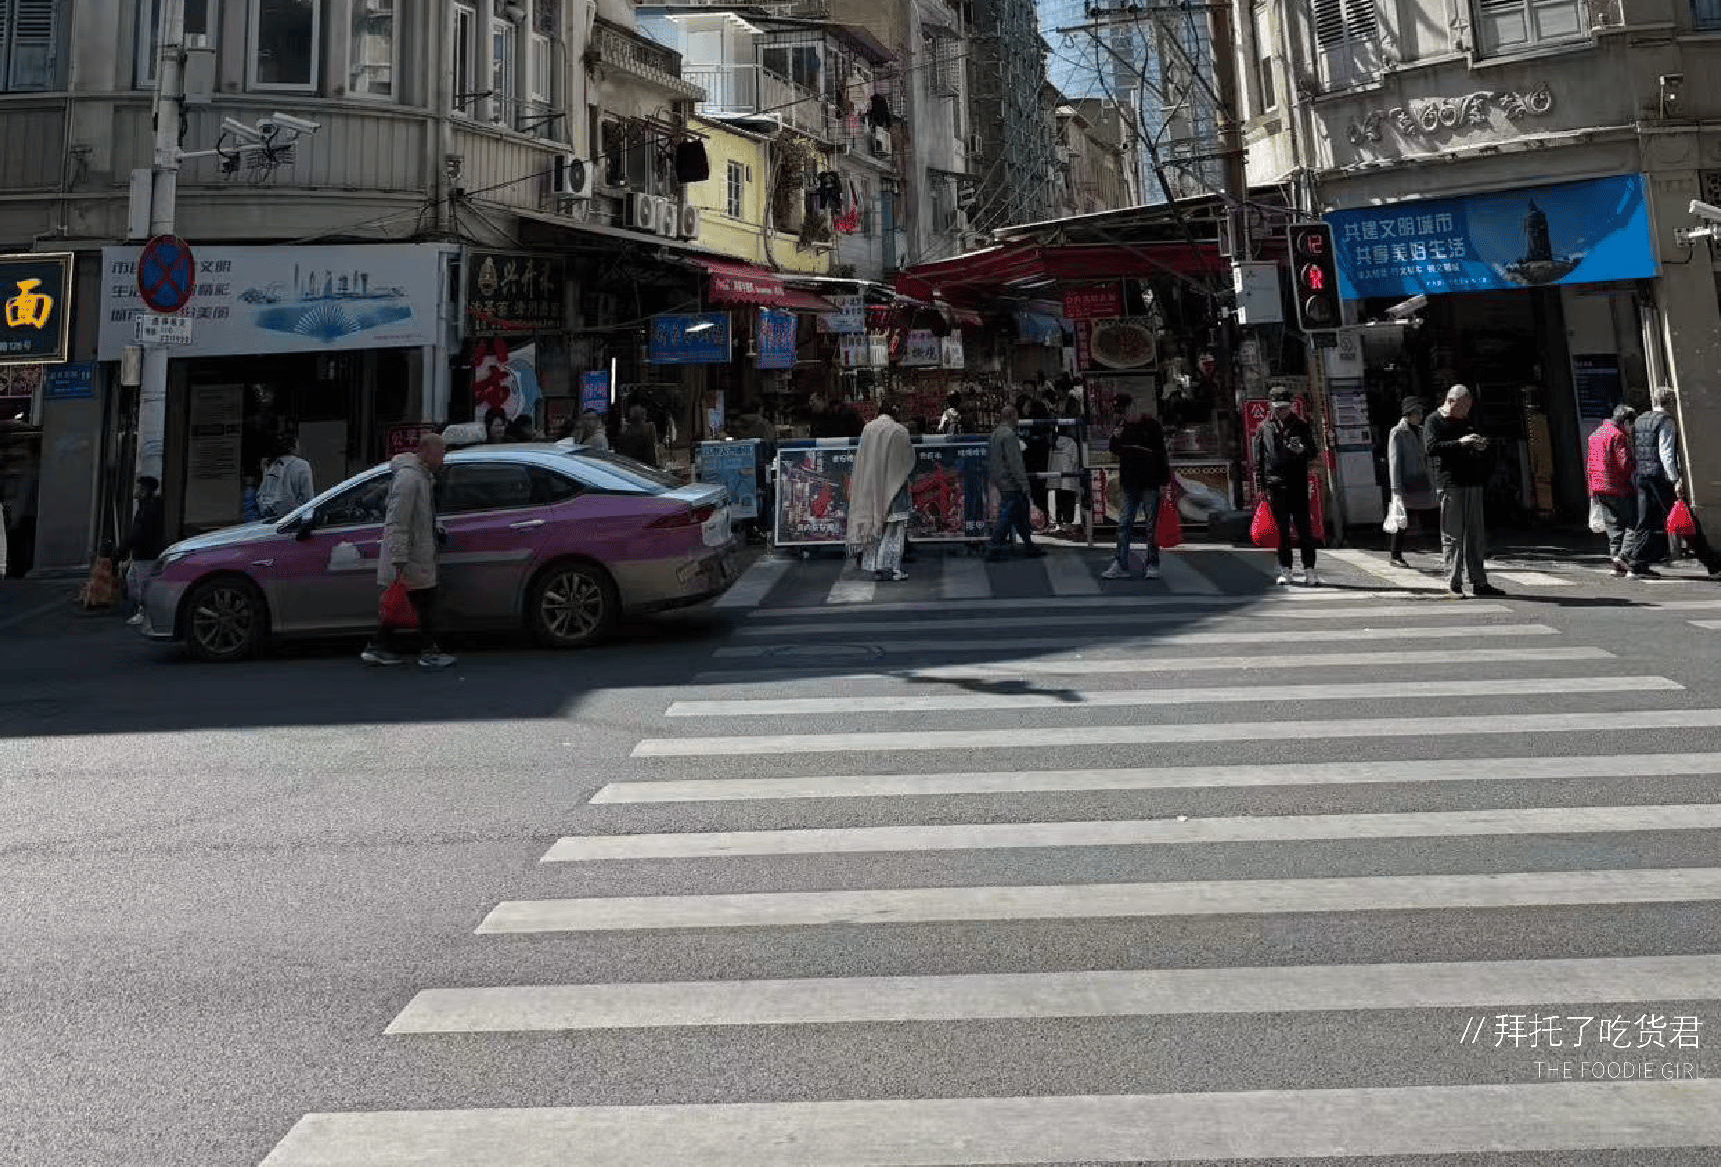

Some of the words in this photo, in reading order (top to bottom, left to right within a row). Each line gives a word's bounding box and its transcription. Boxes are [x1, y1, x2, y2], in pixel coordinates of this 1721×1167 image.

[1342, 213, 1453, 242] 共建文明城市
[1356, 237, 1466, 265] 共享美好生活
[6, 278, 55, 330] 面
